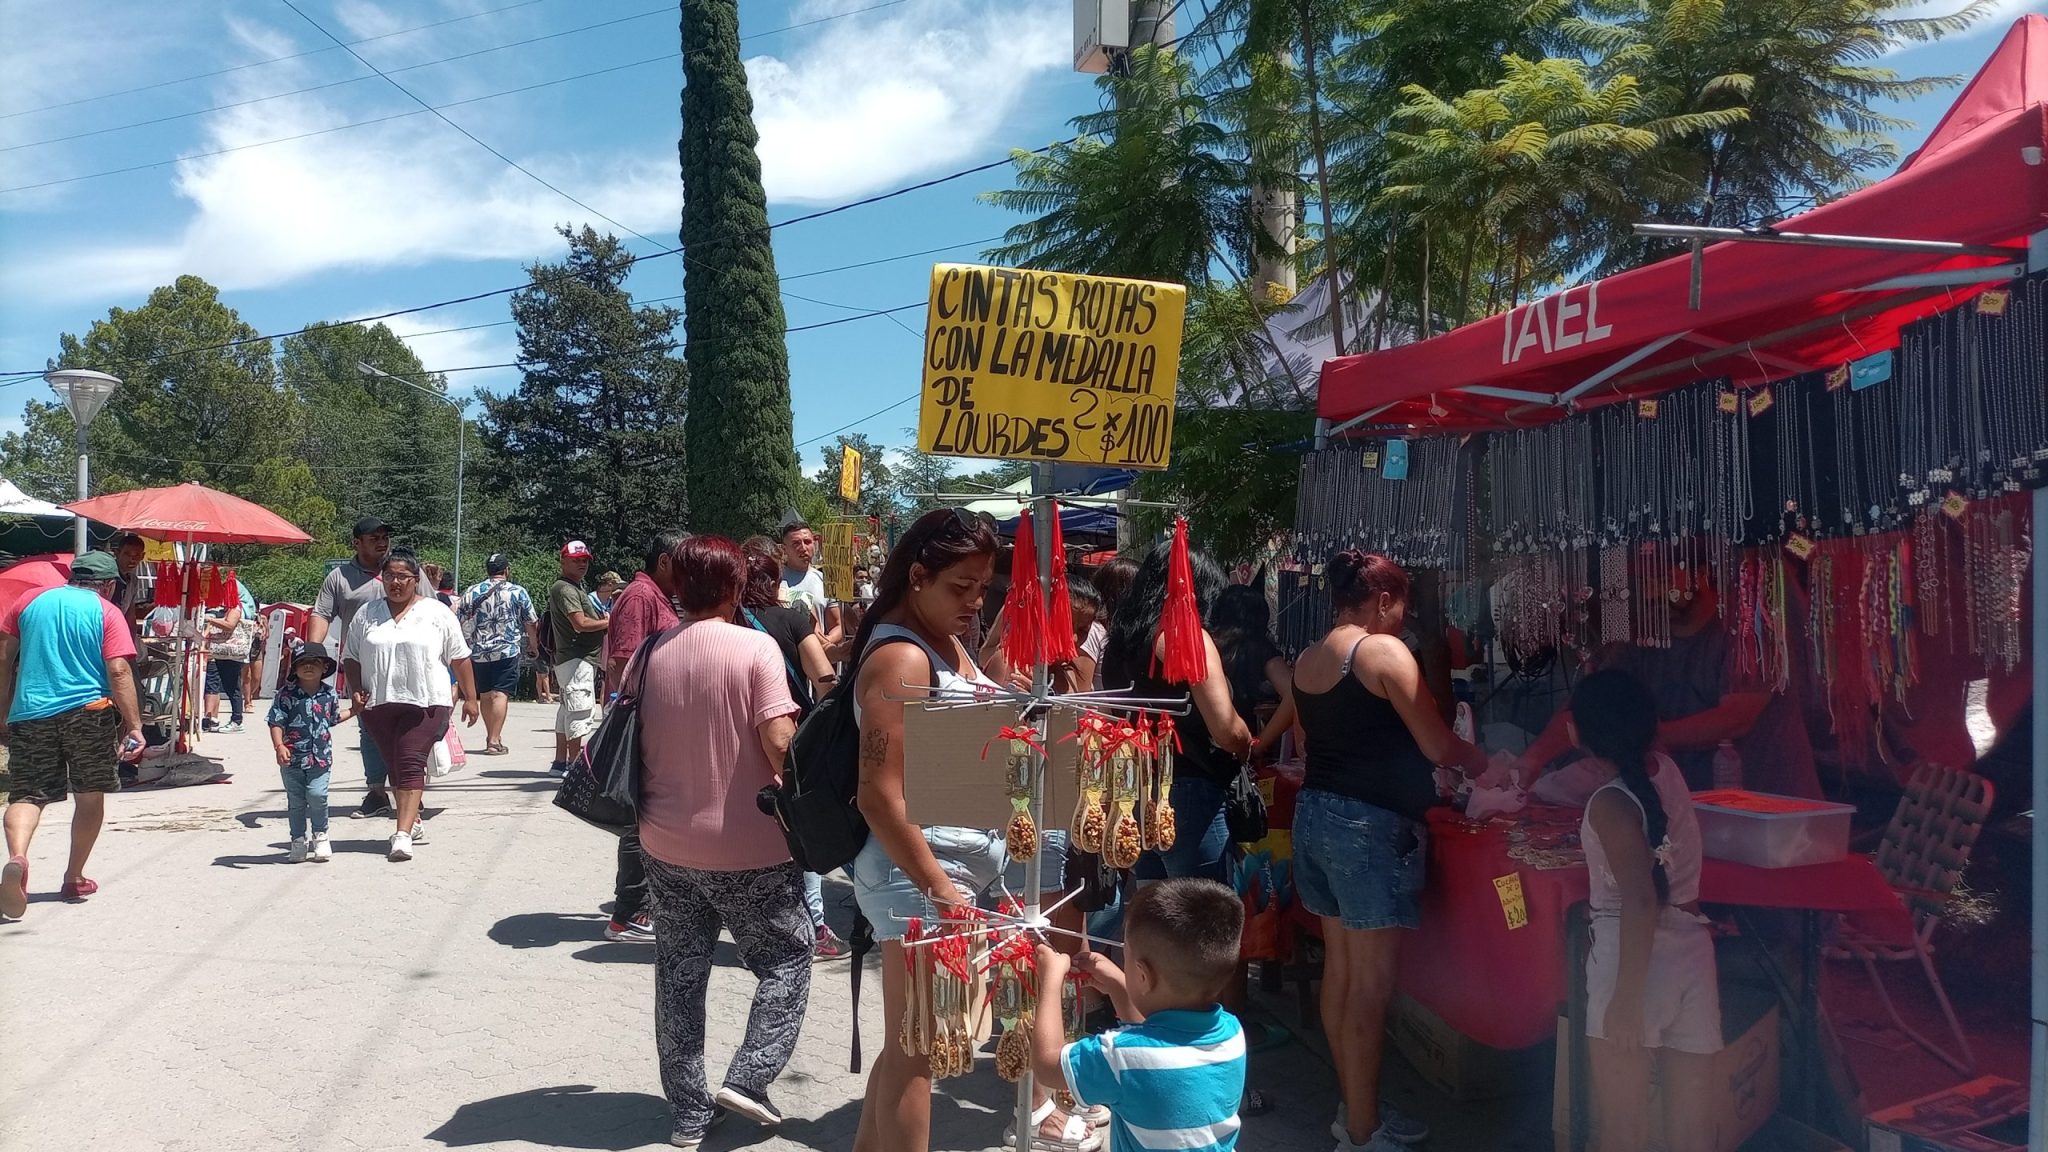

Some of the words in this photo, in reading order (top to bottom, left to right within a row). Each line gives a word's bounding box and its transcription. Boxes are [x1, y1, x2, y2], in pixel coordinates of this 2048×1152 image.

[937, 267, 1059, 329] CINTAS
[1066, 279, 1157, 338] ROJAS
[929, 325, 985, 372] CON
[989, 326, 1035, 378] LA
[1034, 331, 1157, 395] MEDALLA
[931, 375, 975, 411] DE
[931, 408, 1070, 458] LOURDES
[1070, 388, 1099, 431] 2
